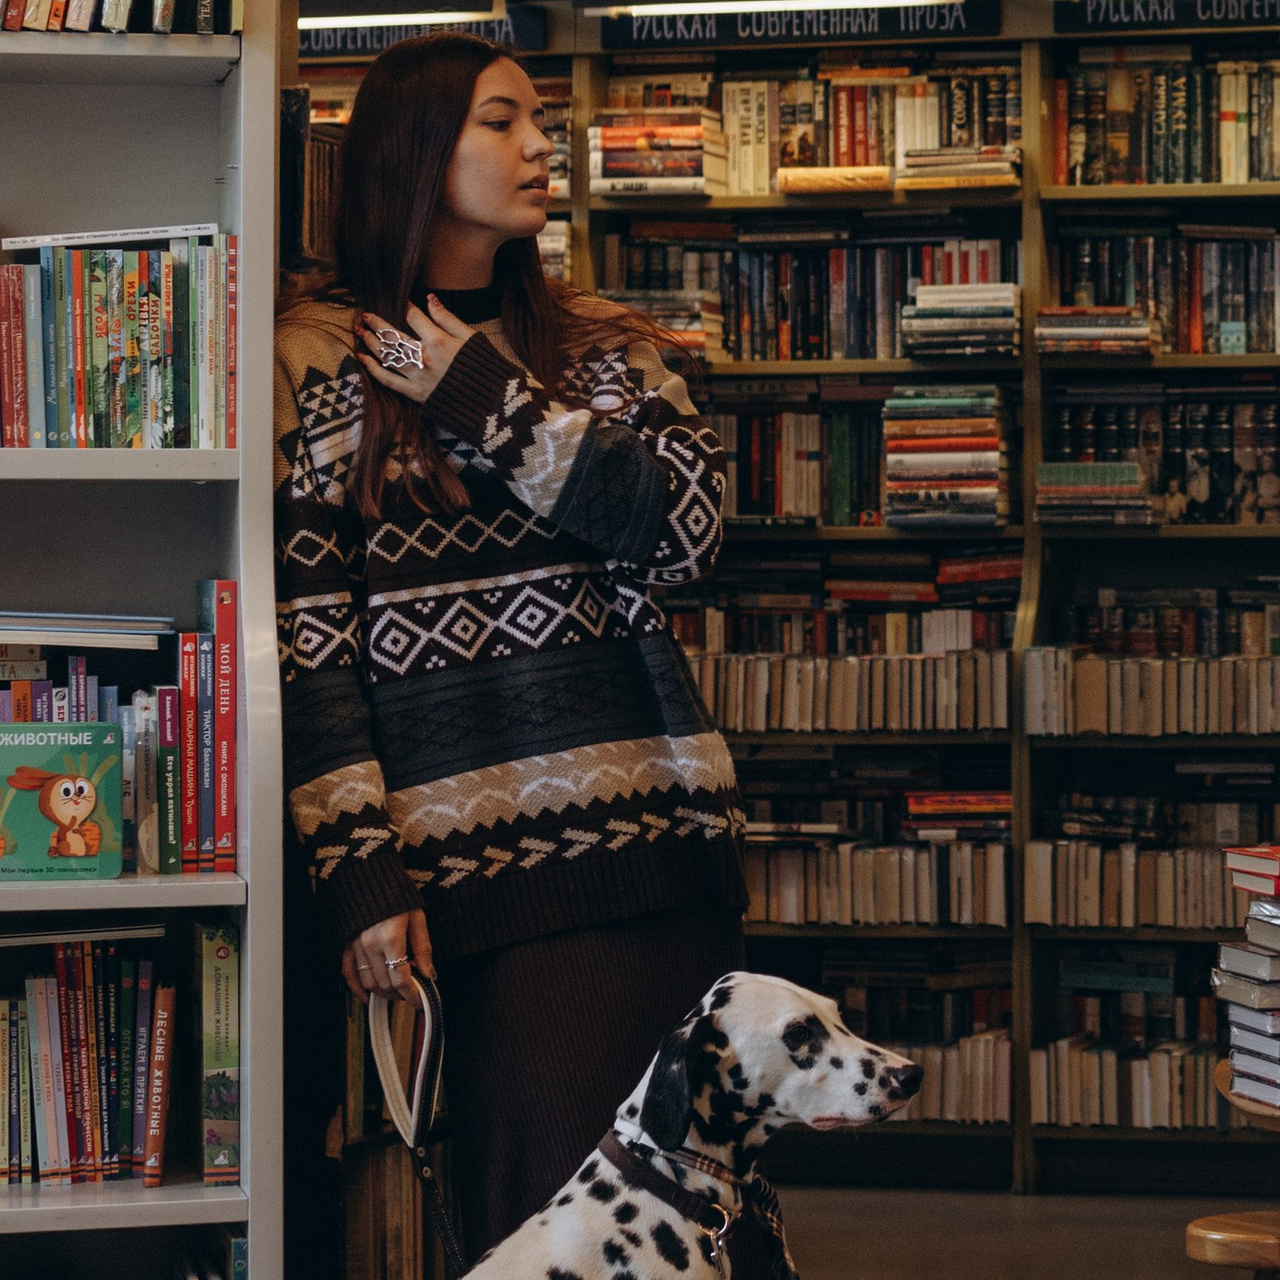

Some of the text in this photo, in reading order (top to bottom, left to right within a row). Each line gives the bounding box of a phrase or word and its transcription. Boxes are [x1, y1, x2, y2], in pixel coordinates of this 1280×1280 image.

[738, 8, 880, 38] СОВРЕМЕННАЯ
[901, 5, 966, 31] ПРОЗА
[126, 281, 136, 321] ОРЕХИ
[164, 264, 172, 307] ЖИВОТНЫЕ
[94, 294, 104, 338] ЯГОДЫ
[139, 297, 149, 351] ДЕРЕВЬЯ
[150, 299, 160, 355] БАБОЧКИ
[218, 643, 231, 714] МОЙ ДЕНЬ
[0, 732, 92, 746] ЖИВОТНЫЕ
[203, 709, 211, 788] ТРАКТОР Баклажан
[220, 741, 228, 764] КНИГА
[166, 773, 174, 797] украл
[185, 710, 194, 825] ПОЖАРНАЯ МАШИНА Тушик
[220, 773, 228, 816] ОКОШКАМИ
[214, 966, 222, 1062] ДОМАШНИЕ ЖИВОТНЫЕ
[136, 1027, 147, 1062] ИГРАЕМ
[64, 1062, 72, 1093] ВРЕМЕНА
[149, 1010, 167, 1136] ЛЕСНЫЕ ЖИВОТНЫЕ
[135, 1076, 145, 1114] ПРЯТКИ!
